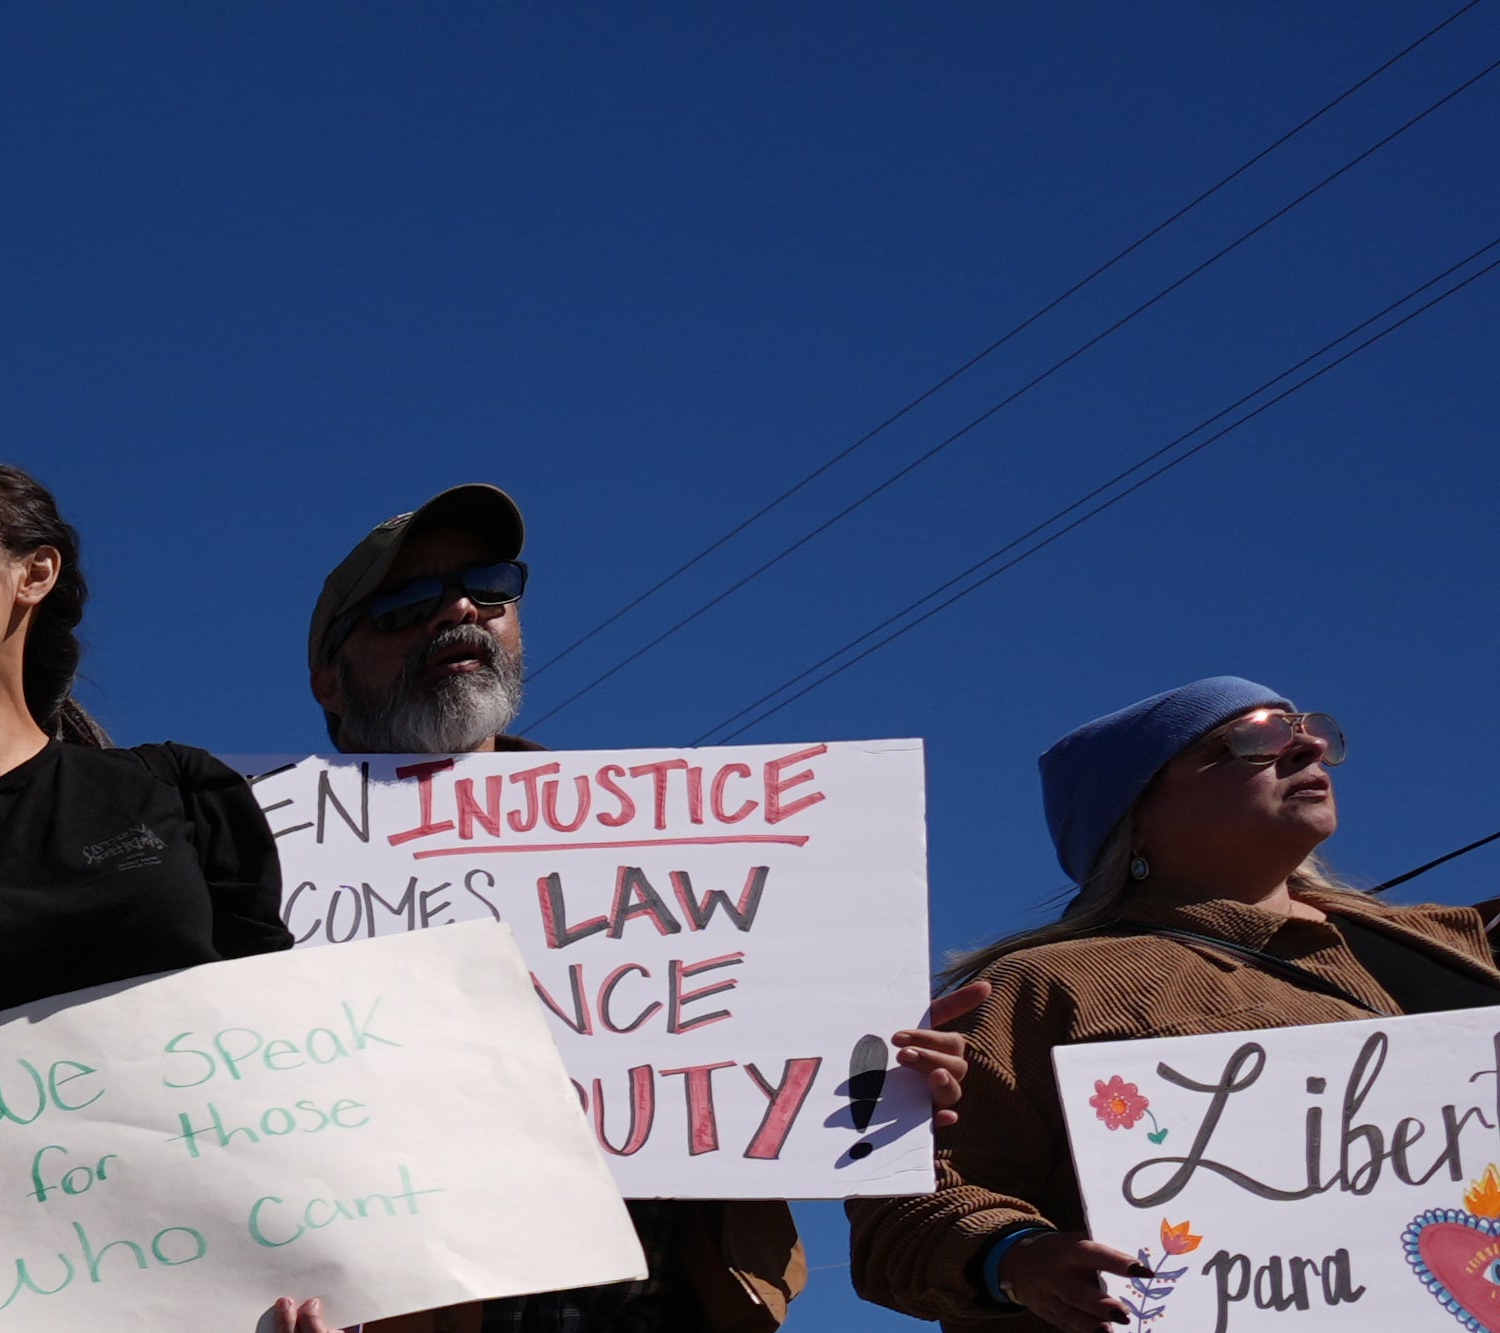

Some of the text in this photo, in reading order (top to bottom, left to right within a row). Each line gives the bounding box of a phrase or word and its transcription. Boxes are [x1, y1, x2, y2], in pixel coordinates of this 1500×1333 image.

[387, 743, 828, 848] INJUSTICE
[283, 865, 770, 949] COMES LAW
[26, 1098, 371, 1203] for those
